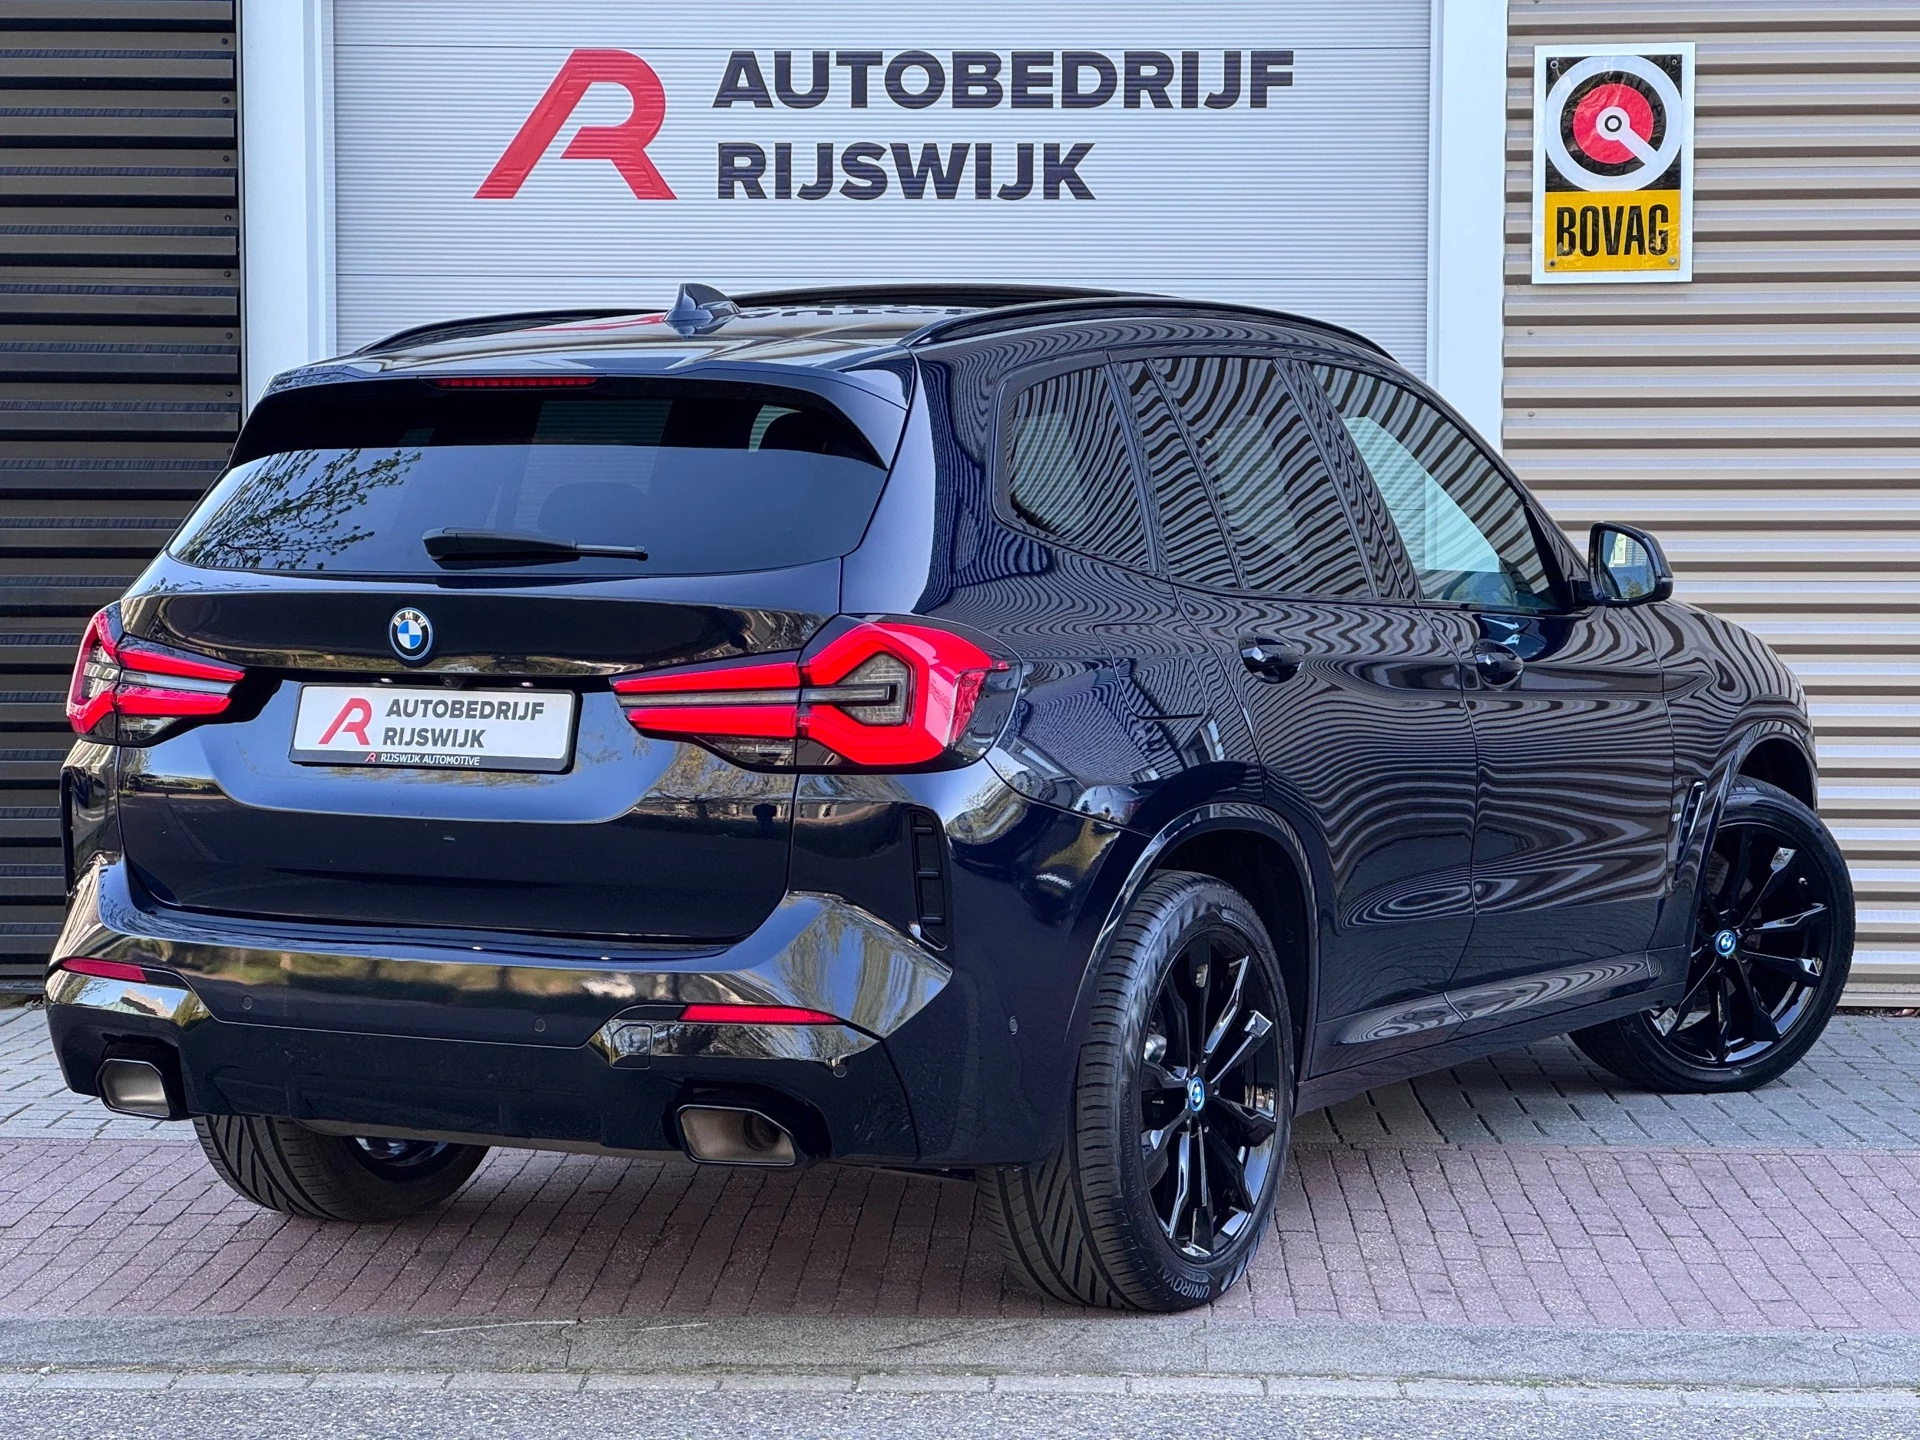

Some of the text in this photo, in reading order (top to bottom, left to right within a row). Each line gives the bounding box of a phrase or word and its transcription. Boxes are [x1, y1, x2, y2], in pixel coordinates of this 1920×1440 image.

[713, 51, 1294, 109] AUTOBEDRIJF
[718, 143, 1095, 199] RIJSWIJK
[1556, 204, 1669, 256] BOVAG
[386, 699, 544, 721] AUTOBEDRIJF
[382, 727, 485, 748] RIJSWIJK
[380, 753, 420, 764] RIJSWIJK
[422, 755, 480, 766] AUTOMOTIVE
